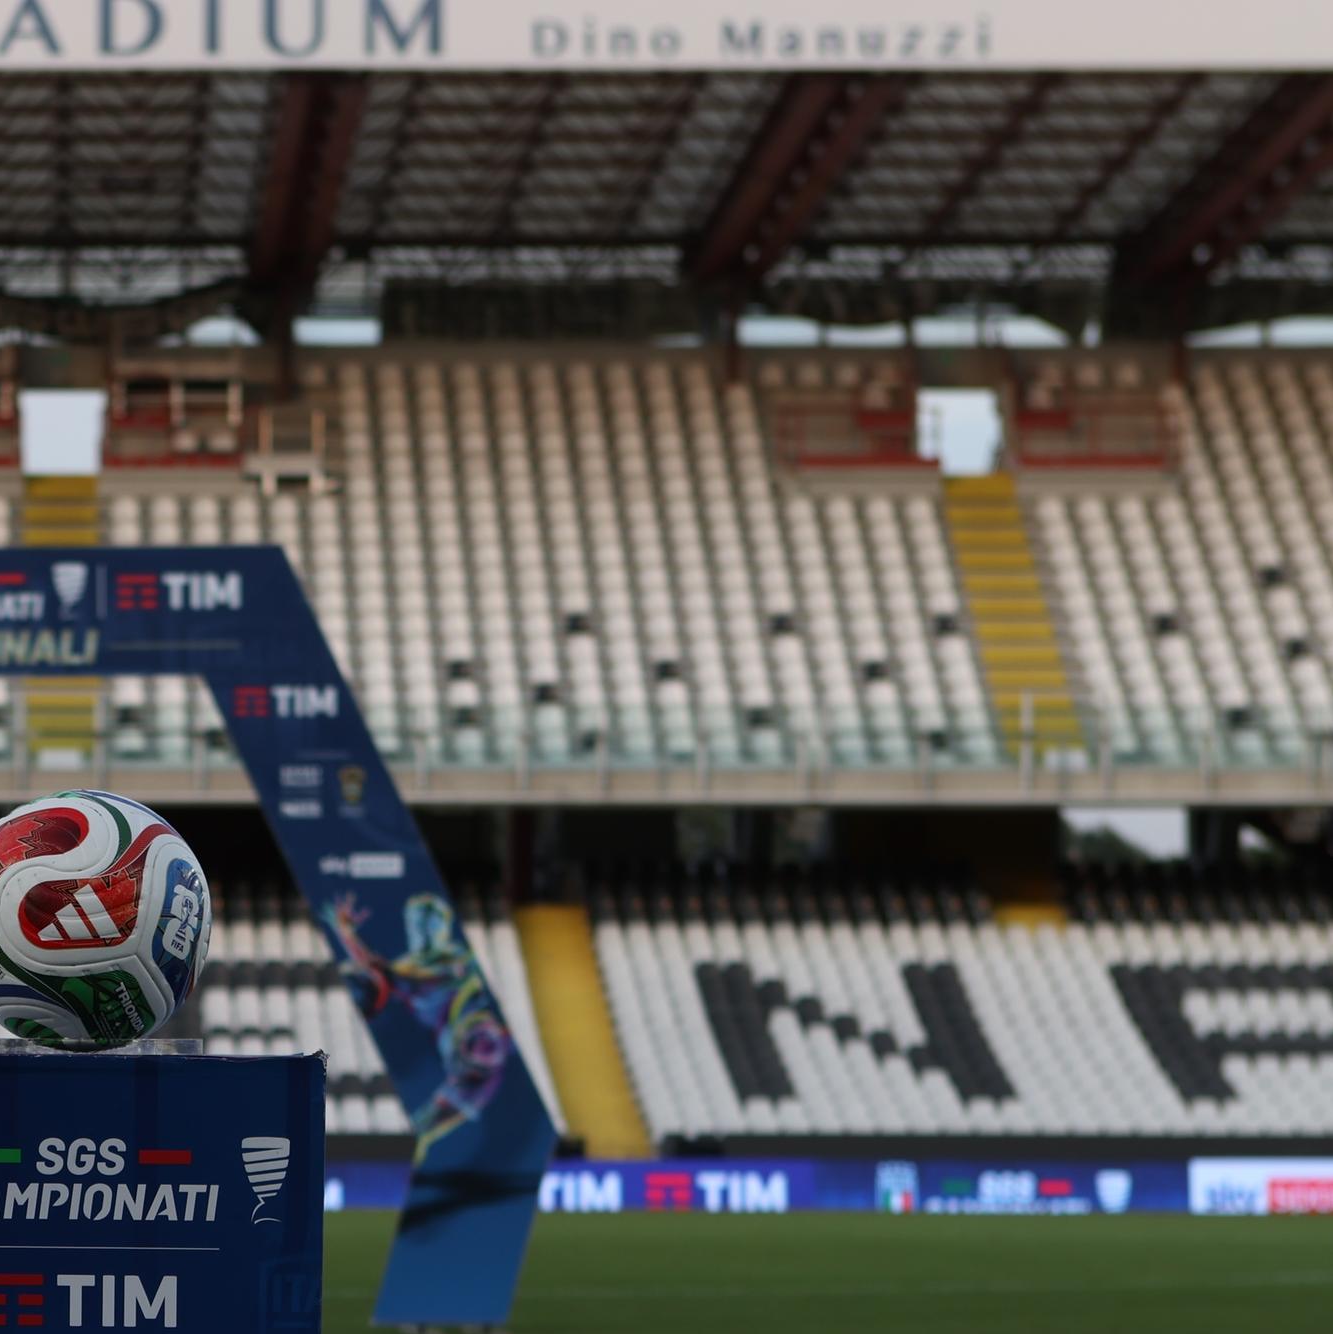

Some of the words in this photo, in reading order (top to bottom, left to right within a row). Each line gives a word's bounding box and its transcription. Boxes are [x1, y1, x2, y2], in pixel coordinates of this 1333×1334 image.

[532, 20, 682, 58] Dino
[719, 20, 993, 58] Manuzzi
[163, 573, 242, 610] TIM
[270, 684, 338, 718] TIM
[170, 939, 185, 953] FIFA
[36, 1137, 126, 1176] SGS
[696, 1170, 788, 1211] TIM
[57, 1274, 178, 1328] TIM
